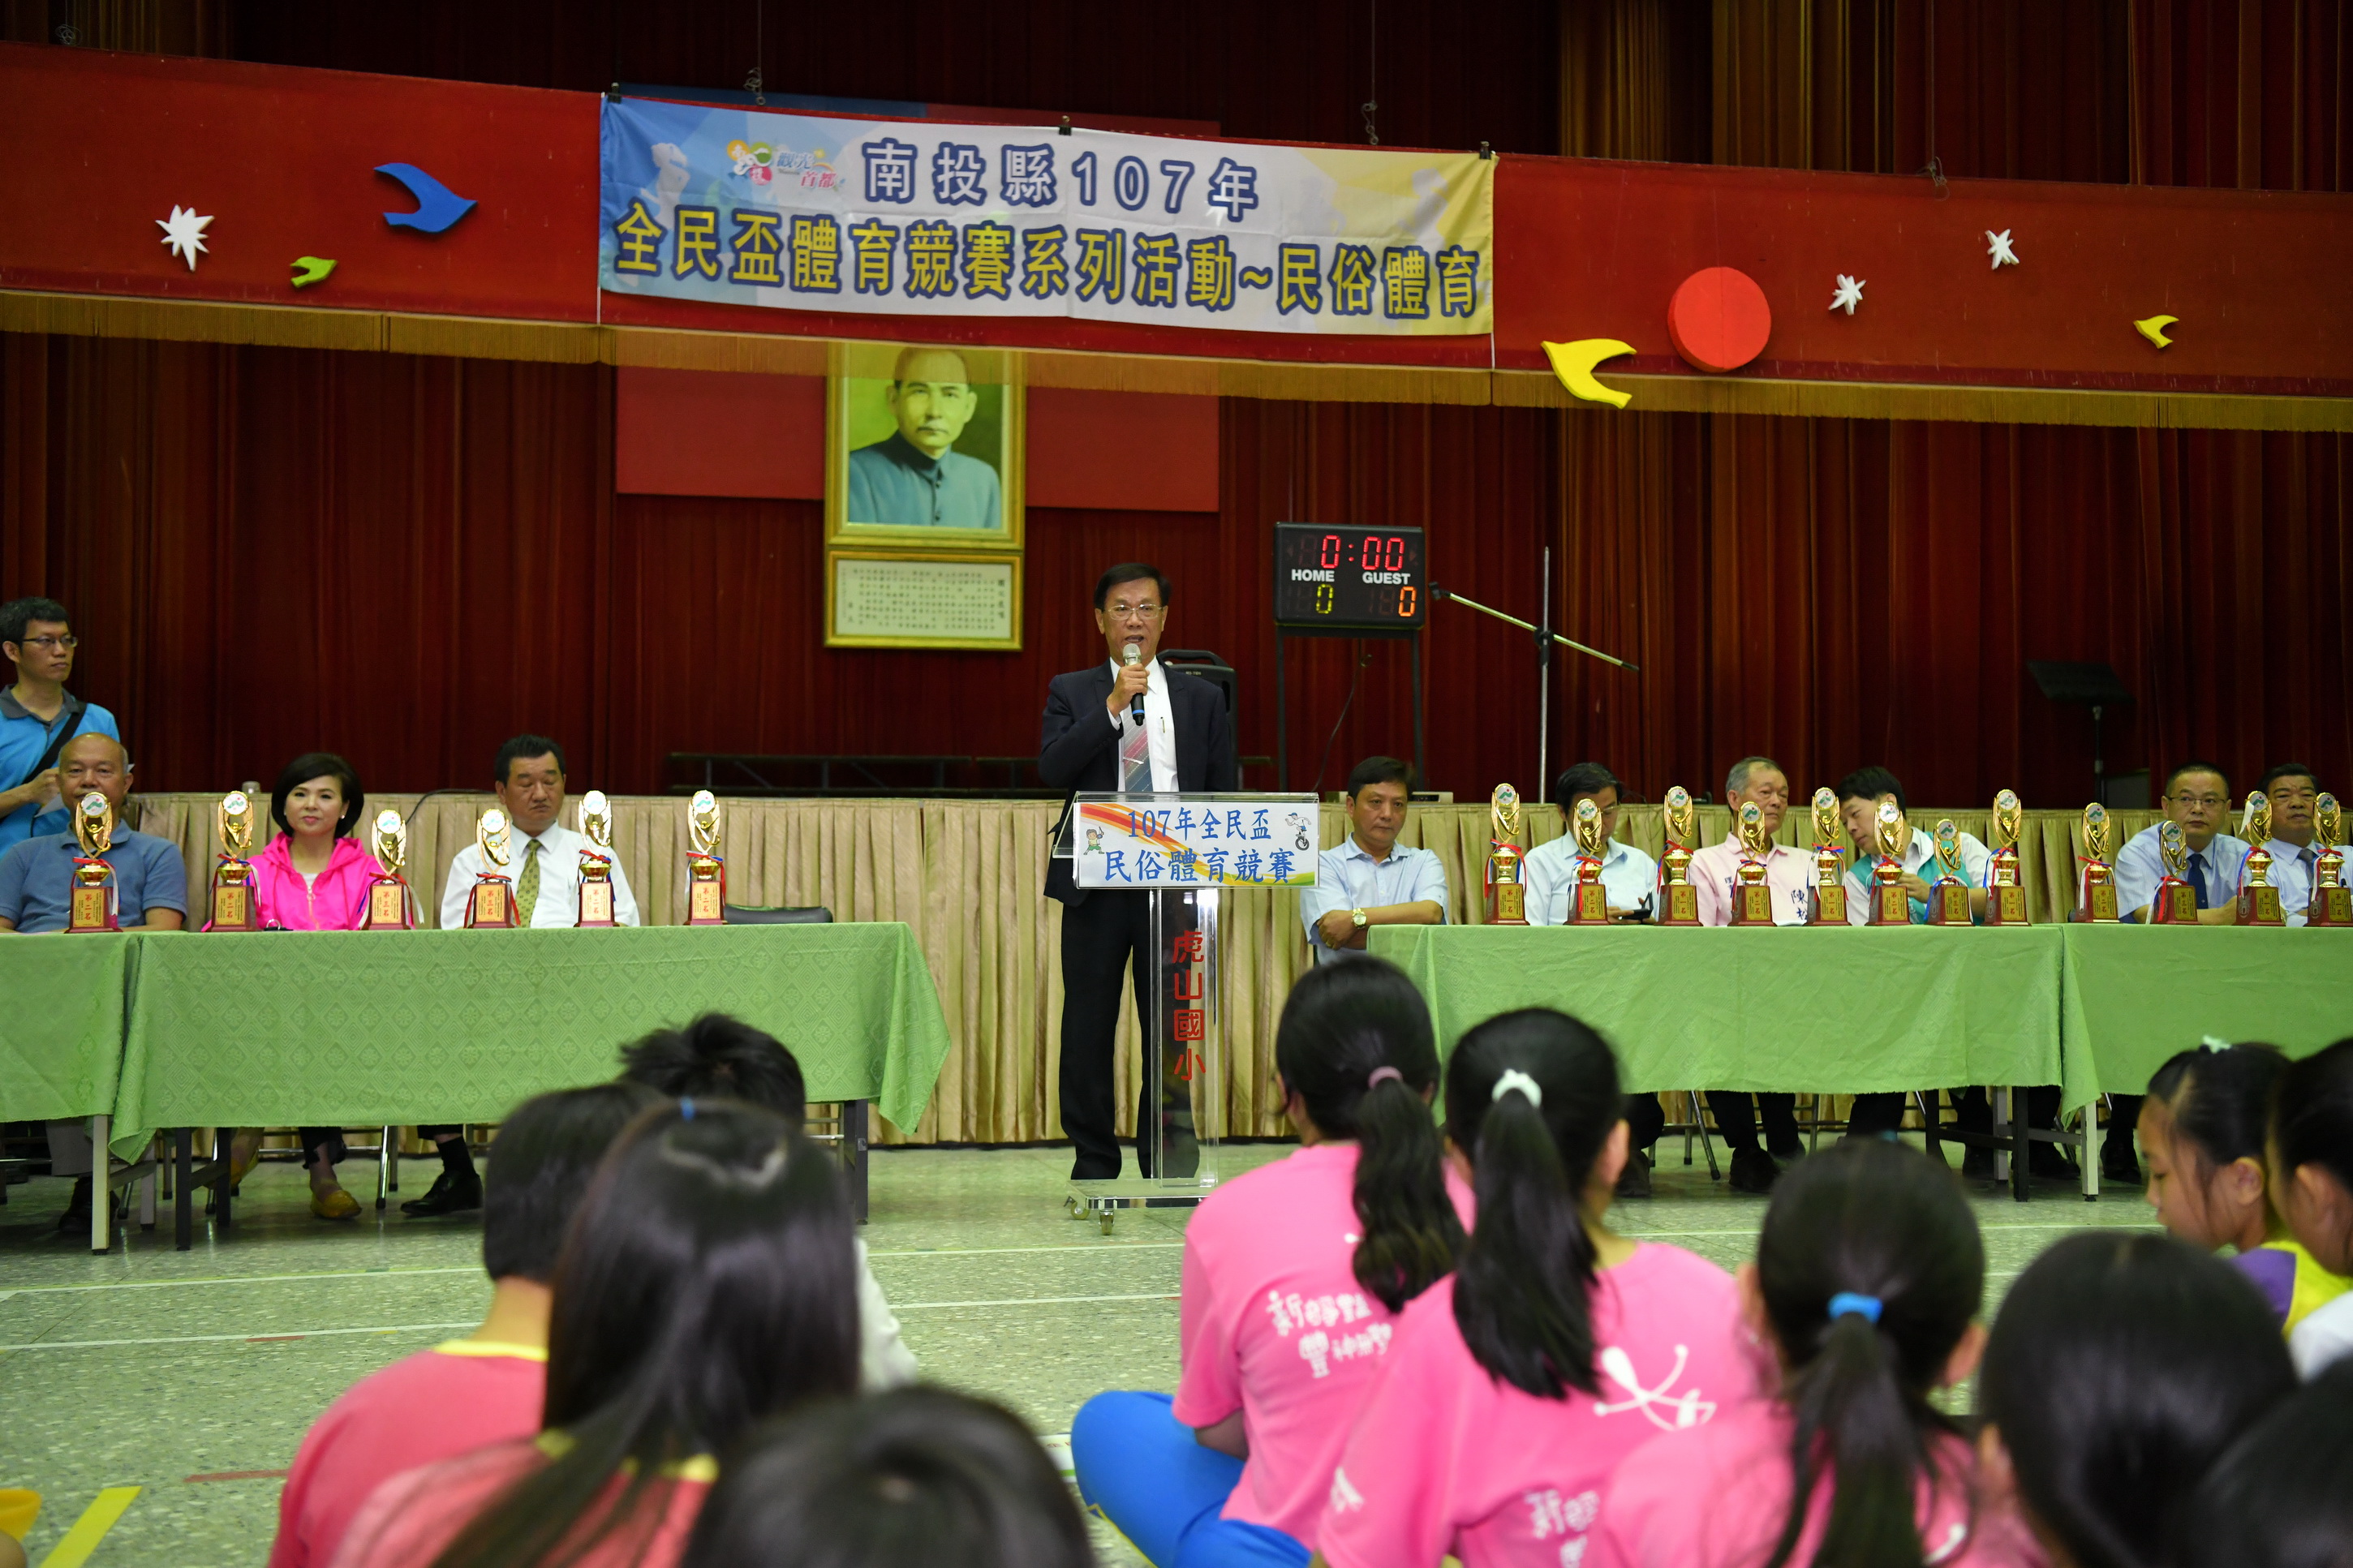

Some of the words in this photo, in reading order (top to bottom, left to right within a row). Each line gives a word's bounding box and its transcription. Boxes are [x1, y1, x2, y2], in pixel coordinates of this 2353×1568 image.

[862, 138, 1258, 222] 南投縣107年
[1321, 535, 1405, 571] 0:00
[1291, 569, 1335, 582] HOME
[1362, 572, 1411, 585] GUEST
[1315, 583, 1334, 614] 0
[1398, 586, 1417, 617] 0
[1128, 806, 1271, 841] 107年全民盃
[1104, 847, 1297, 884] 民俗體育競賽
[1172, 930, 1206, 1081] 虎山國小
